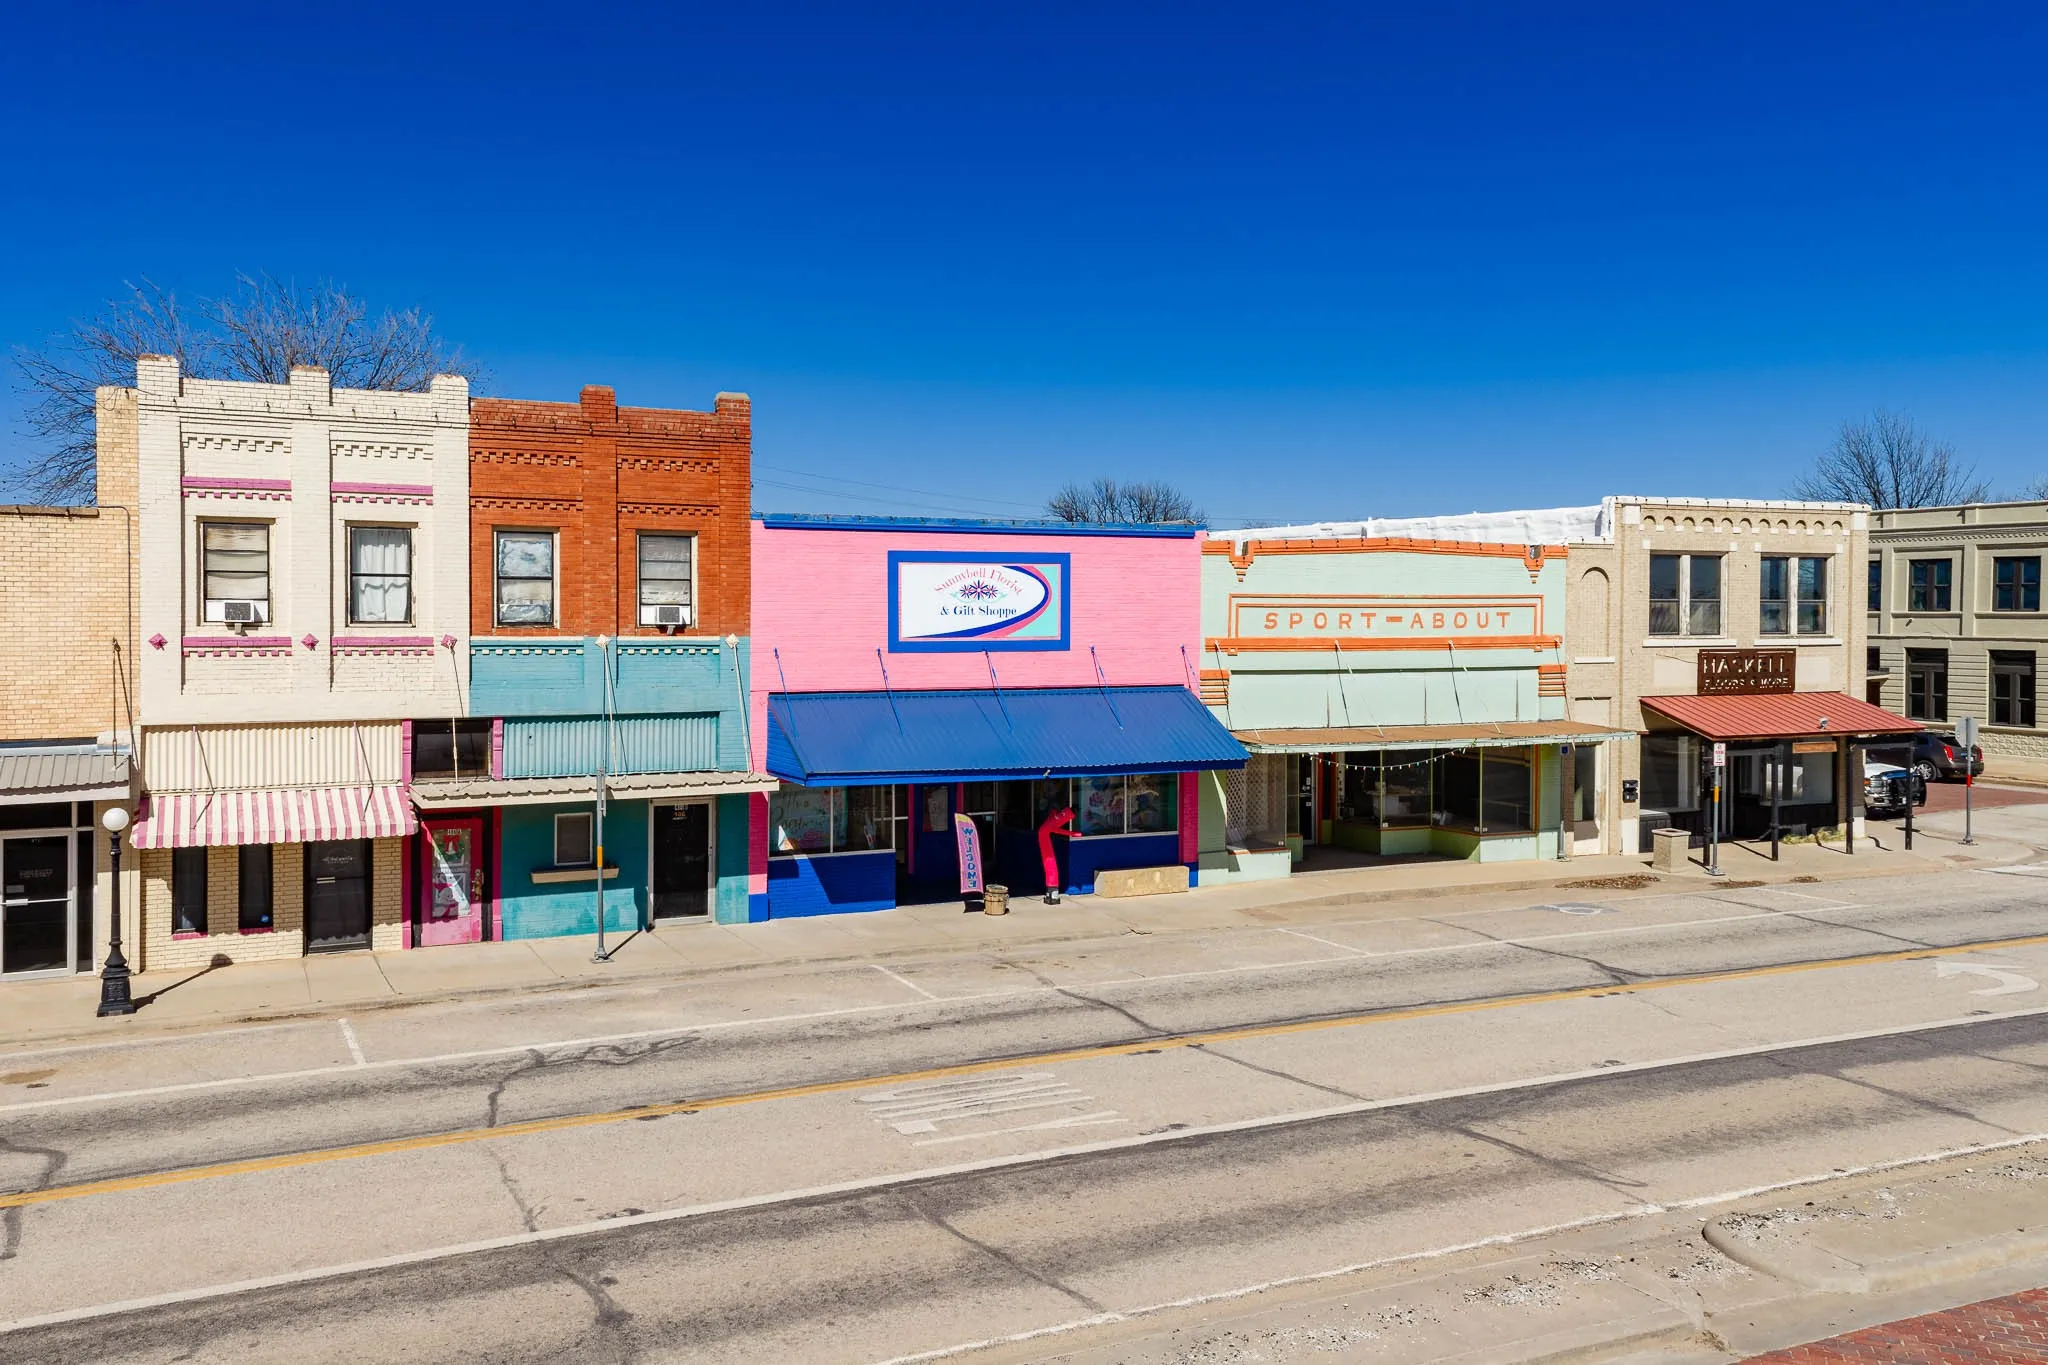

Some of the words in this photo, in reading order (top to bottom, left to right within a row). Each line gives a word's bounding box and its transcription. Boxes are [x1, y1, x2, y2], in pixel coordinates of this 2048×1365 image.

[935, 567, 986, 592] Sunnybell
[990, 568, 1023, 596] Florist
[940, 605, 950, 616] &
[953, 604, 976, 616] Gift
[979, 604, 1017, 618] Shoppe
[1263, 611, 1511, 630] SPORT-ABOUT
